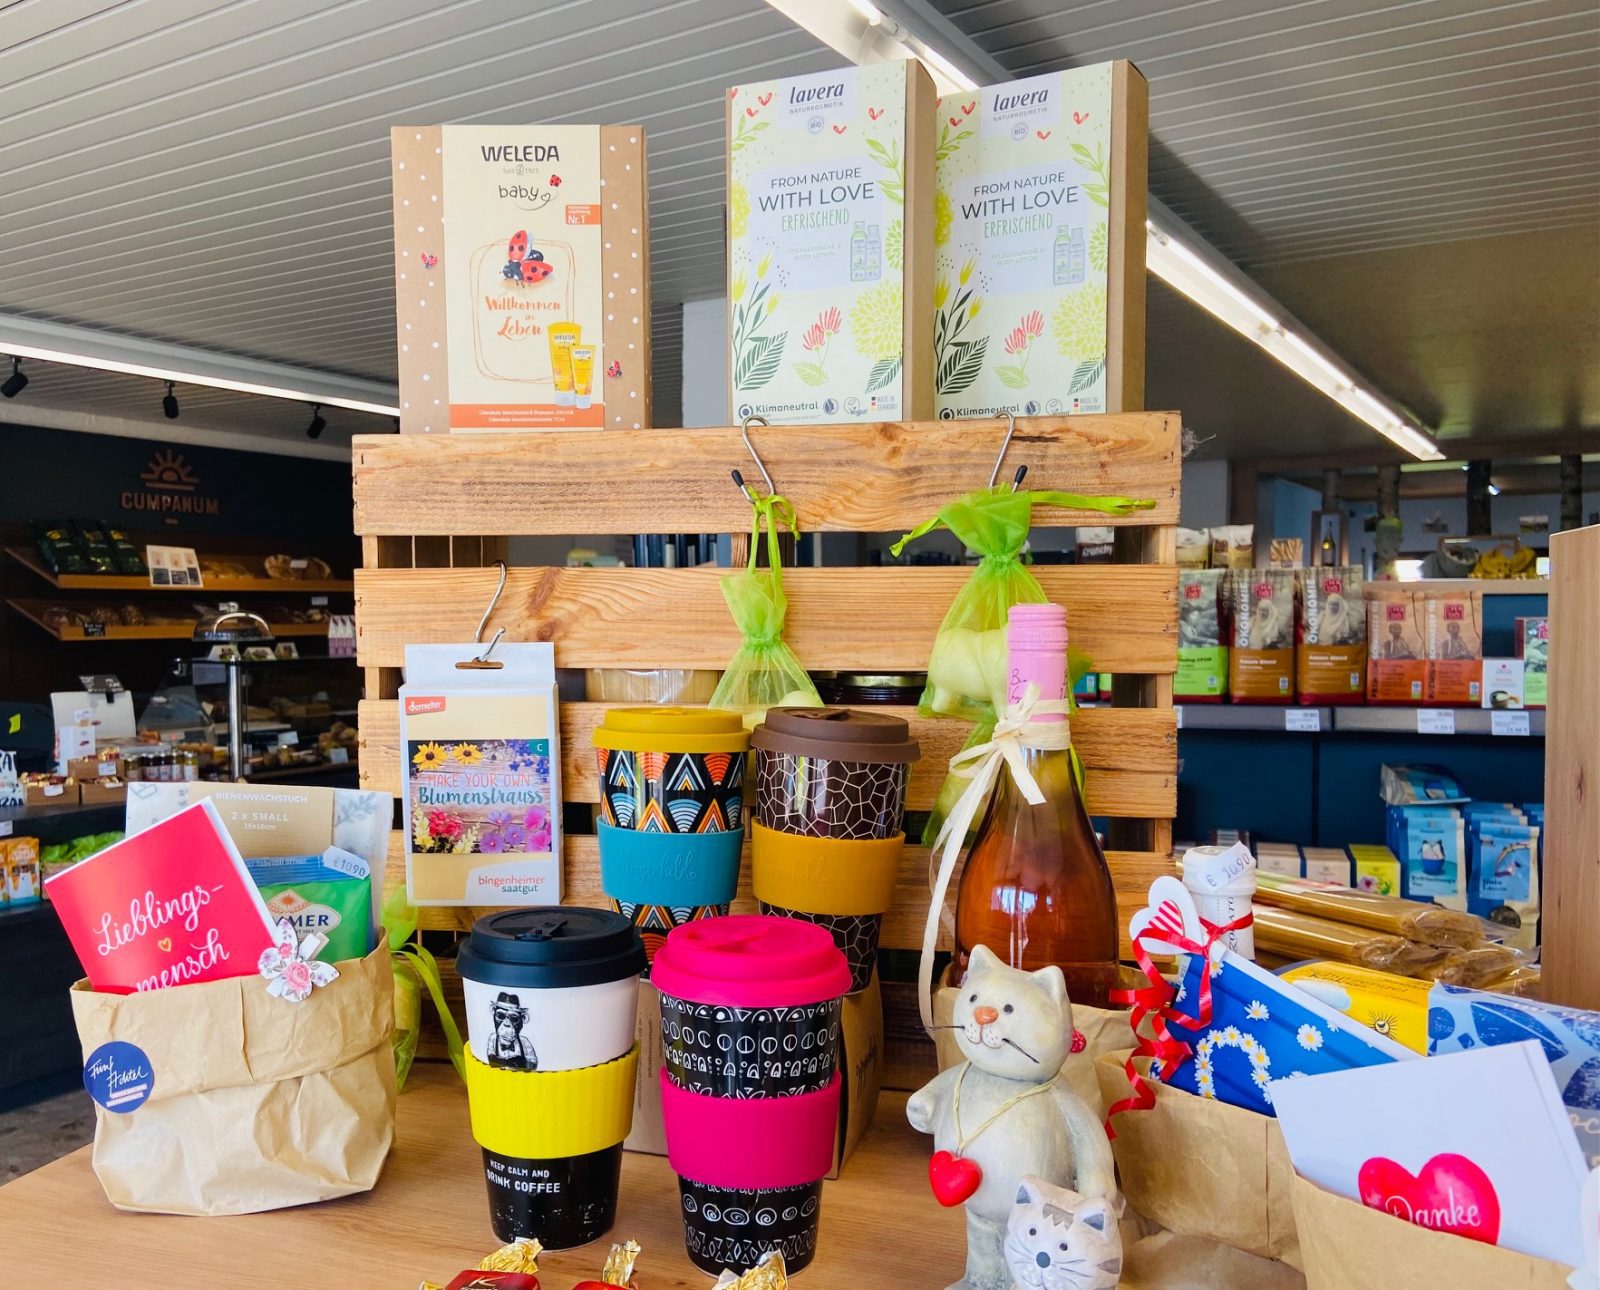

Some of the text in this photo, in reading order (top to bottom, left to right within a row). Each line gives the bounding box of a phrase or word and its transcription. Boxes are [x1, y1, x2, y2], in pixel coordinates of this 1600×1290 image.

[789, 83, 845, 104] lavera
[993, 89, 1049, 112] lavera
[789, 101, 844, 115] NATURKOSMETIK
[992, 107, 1048, 122] NATURKOSMETIK
[481, 146, 560, 162] WELEDA
[771, 167, 862, 189] FROM NATURE
[973, 171, 1066, 197] FROM NATURE
[498, 184, 539, 201] baby
[758, 182, 875, 213] WITH LOVE
[961, 186, 1079, 220] WITH LOVE
[781, 207, 850, 232] ERFRISCHEND
[983, 212, 1053, 239] ERFRISCHEND
[484, 295, 561, 311] Willkommen
[497, 315, 542, 338] Leben
[755, 401, 819, 414] Klimaneutral
[121, 491, 220, 514] CUMPANUM
[408, 702, 442, 712] demeter
[536, 743, 543, 752] C
[428, 773, 531, 788] MAKE YOUR OWN
[215, 792, 308, 803] BIENENWACHSTUCH
[418, 785, 544, 806] Blumenstrauss
[231, 811, 238, 820] 2
[252, 812, 289, 822] SMALL
[478, 875, 545, 887] bingenheimer
[501, 884, 539, 895] saatgut
[92, 884, 224, 956] Lieblings-
[135, 928, 230, 993] mensch
[490, 1159, 550, 1178] KEEP CALM AND
[486, 1168, 561, 1194] DRINK COFFEE
[1384, 1185, 1482, 1228] Danke
